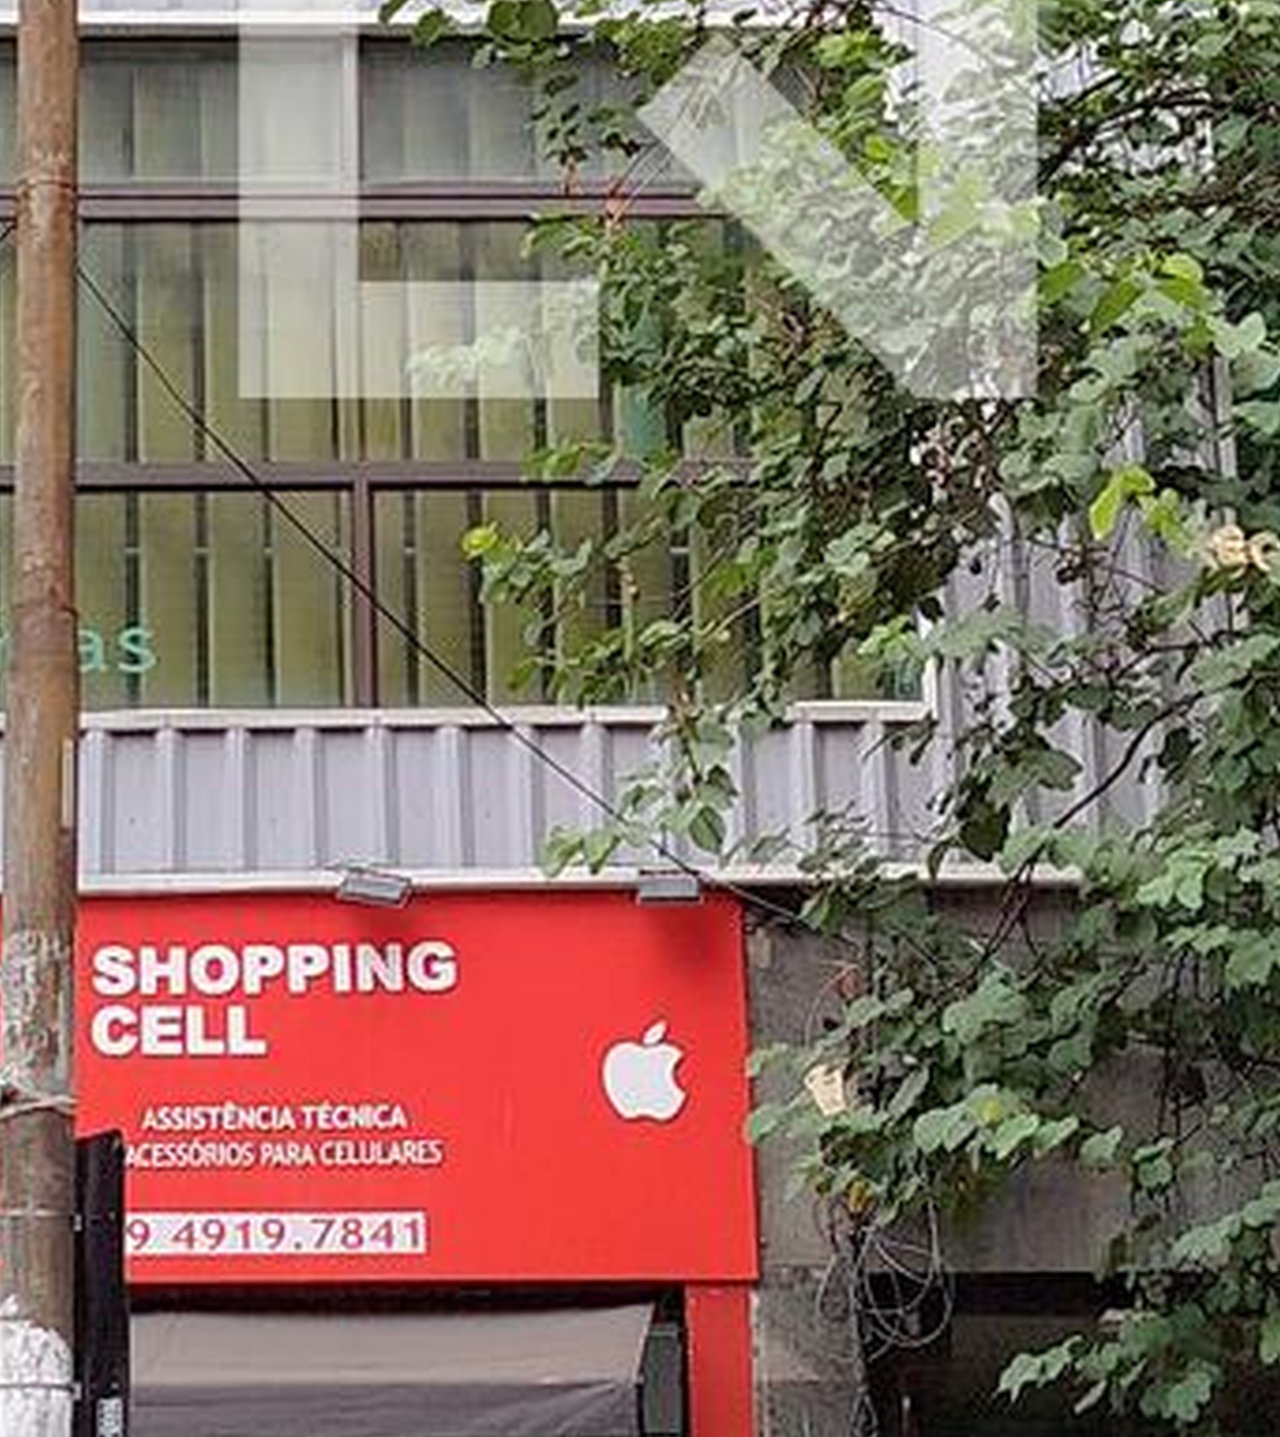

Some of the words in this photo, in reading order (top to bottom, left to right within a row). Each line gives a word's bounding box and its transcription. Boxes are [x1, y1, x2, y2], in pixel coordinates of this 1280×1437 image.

[92, 939, 458, 996] SHOPPING
[92, 1005, 267, 1056] CELL
[141, 1101, 297, 1130] ASSISTÊNCIA
[302, 1101, 407, 1129] TÉCNICA
[125, 1138, 255, 1167] ACESSÓRIOS
[261, 1142, 315, 1165] PARA
[320, 1139, 444, 1166] CELULARES
[172, 1218, 422, 1250] 4919.7841
